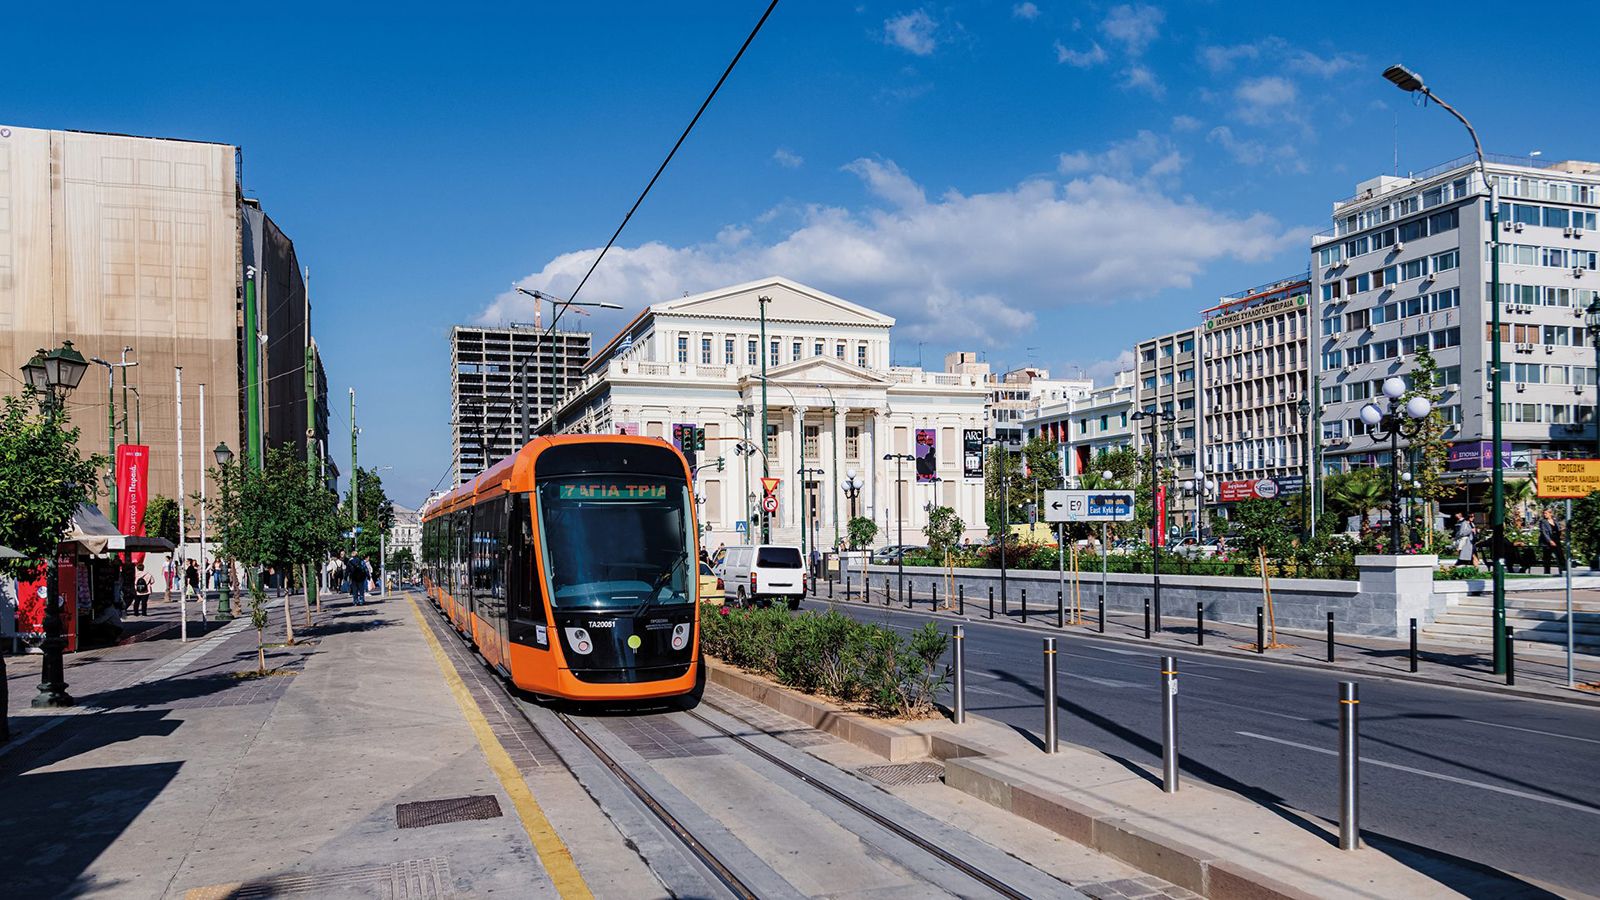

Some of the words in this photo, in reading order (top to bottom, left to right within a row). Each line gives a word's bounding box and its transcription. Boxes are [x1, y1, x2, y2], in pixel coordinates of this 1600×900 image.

[1216, 314, 1240, 326] ΙΑΤΡΙΚΟΣ
[1241, 306, 1269, 320] ΣΥΛΛΟΓΟΣ
[1270, 300, 1294, 312] ΠΕΙΡΑΙΑ
[965, 431, 982, 440] ARC
[1558, 463, 1585, 473] ΠΡΟΣΟΧΗ
[565, 485, 576, 497] 7
[1070, 500, 1082, 511] E9
[1089, 506, 1101, 514] East
[1102, 506, 1125, 515] Kykldes
